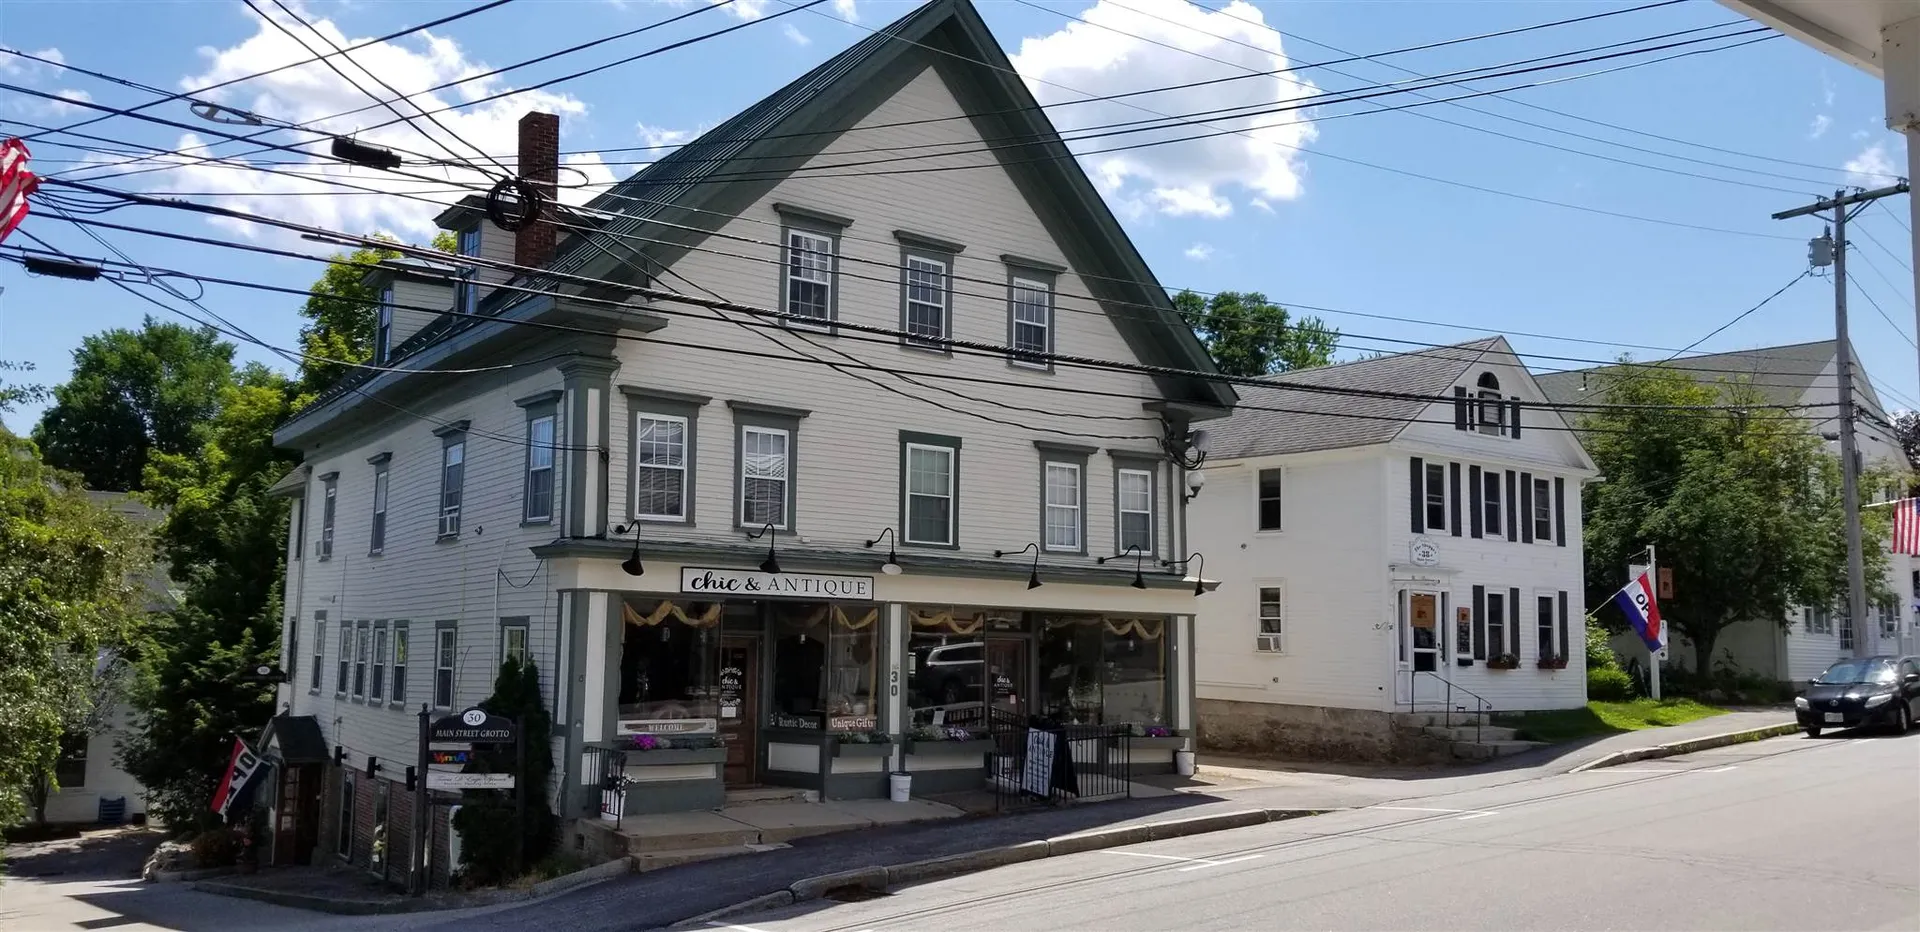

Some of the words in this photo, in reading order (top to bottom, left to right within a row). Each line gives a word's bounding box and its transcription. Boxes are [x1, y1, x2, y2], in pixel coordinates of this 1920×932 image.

[691, 571, 741, 591] chic
[744, 577, 761, 591] &
[767, 577, 866, 596] ANTIQUE
[468, 713, 481, 722] 30
[647, 723, 684, 732] WELCOME
[778, 717, 797, 728] Rustic
[798, 718, 818, 729] Decor
[831, 718, 856, 730] Unique
[856, 718, 874, 729] Gifts
[436, 729, 454, 738] MAIN
[455, 729, 479, 738] STREET
[480, 729, 510, 738] GROTTO
